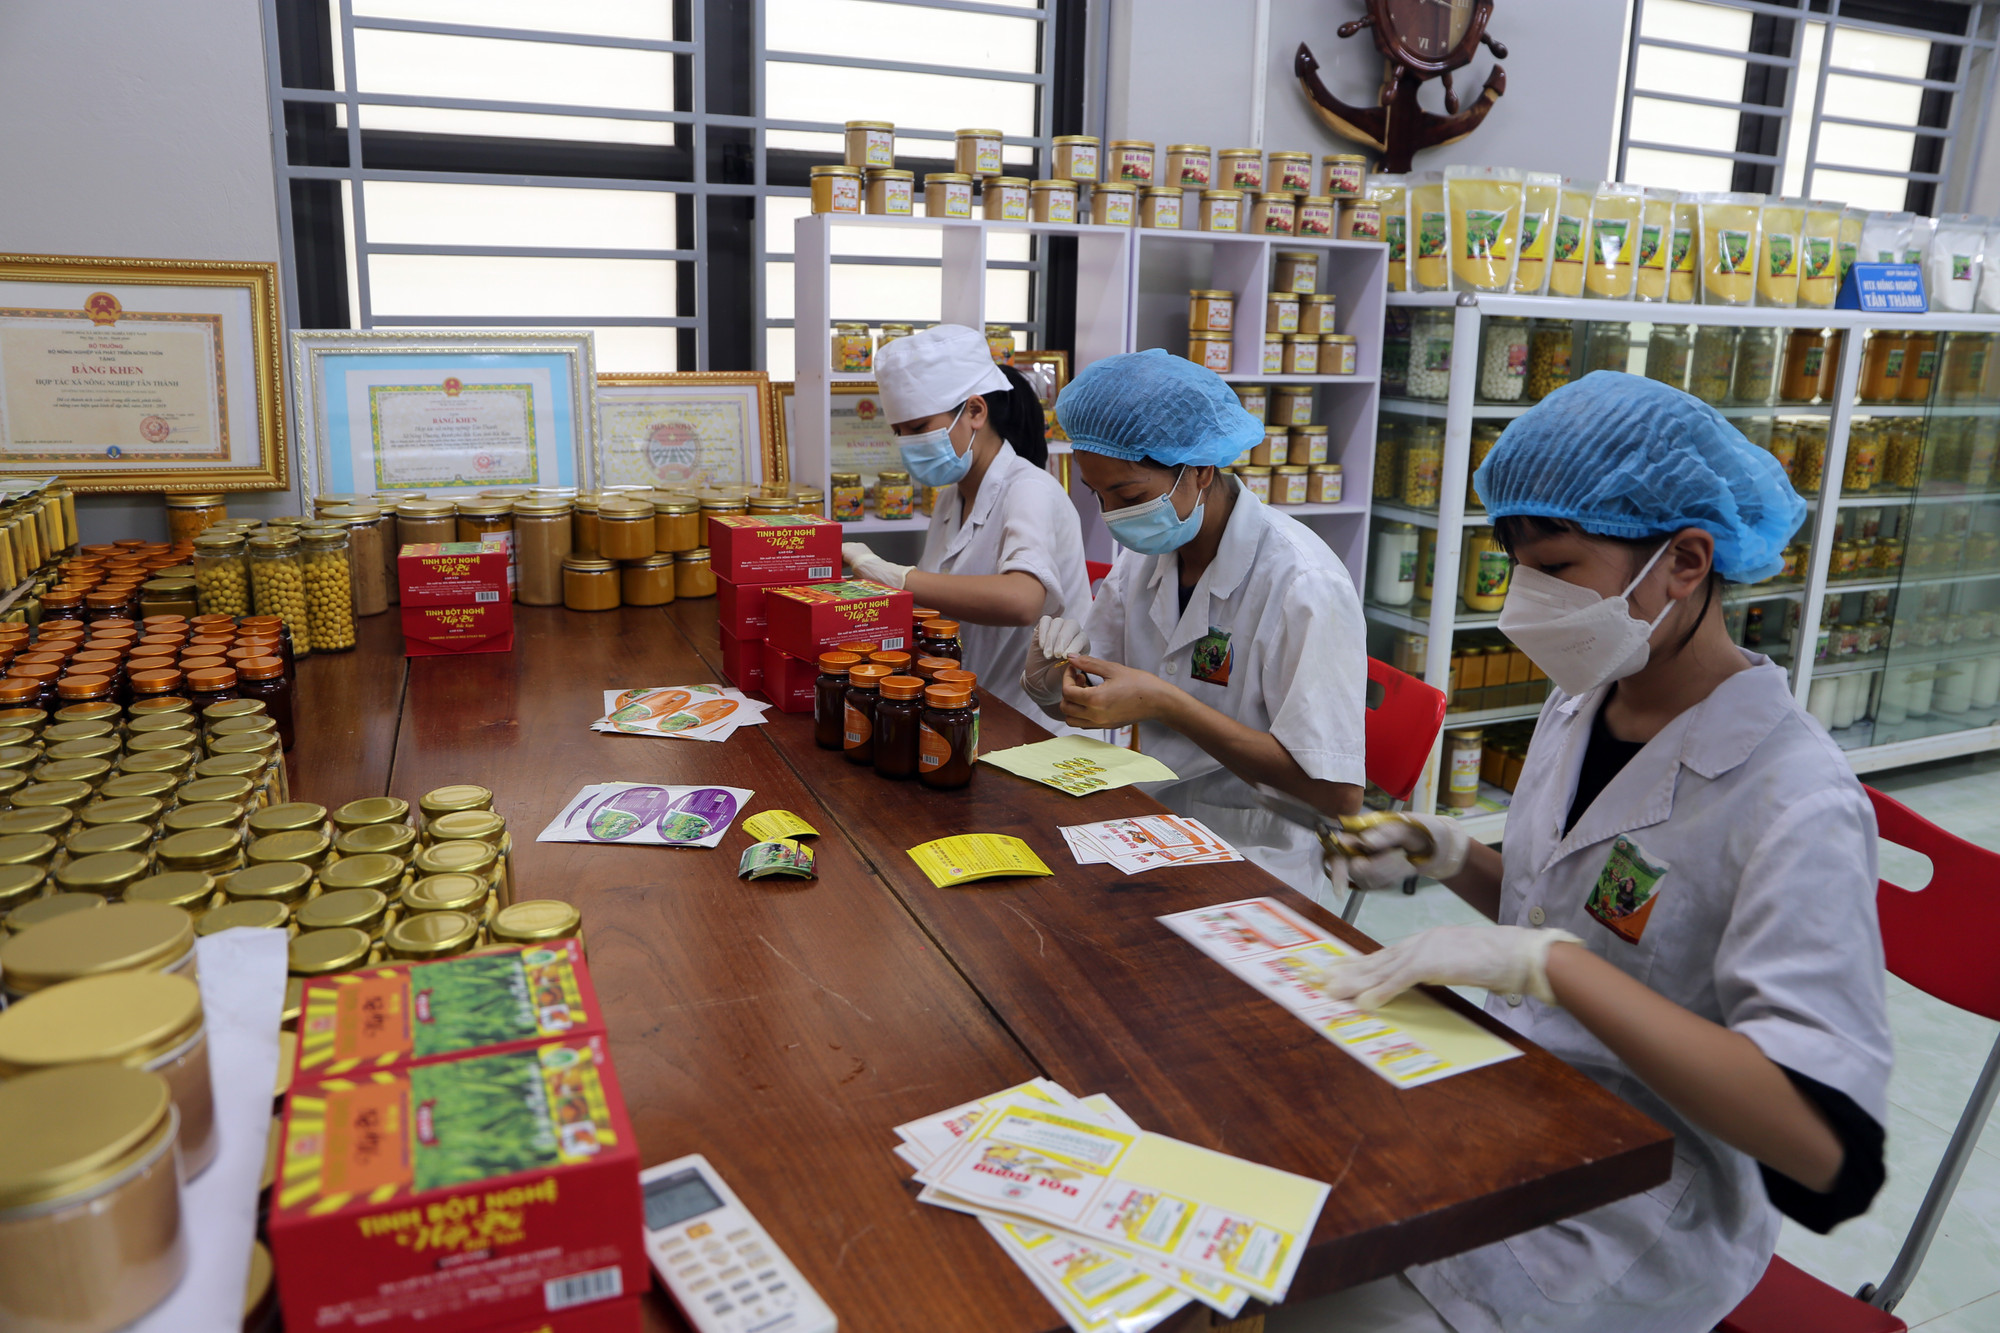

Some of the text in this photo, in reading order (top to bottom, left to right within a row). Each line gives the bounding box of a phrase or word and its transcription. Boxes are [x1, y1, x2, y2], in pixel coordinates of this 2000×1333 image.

[1418, 36, 1429, 50] VI
[1864, 292, 1923, 307] TÂN THÀNH
[109, 366, 144, 374] KHEN
[777, 528, 792, 538] BỘT
[794, 528, 816, 537] NGHỆ
[442, 557, 457, 565] BỘT
[459, 556, 480, 564] NGHỆ
[834, 598, 889, 612] TINH BỘT NGHỆ
[463, 607, 484, 616] NGHỆ
[358, 1208, 422, 1238] TINH
